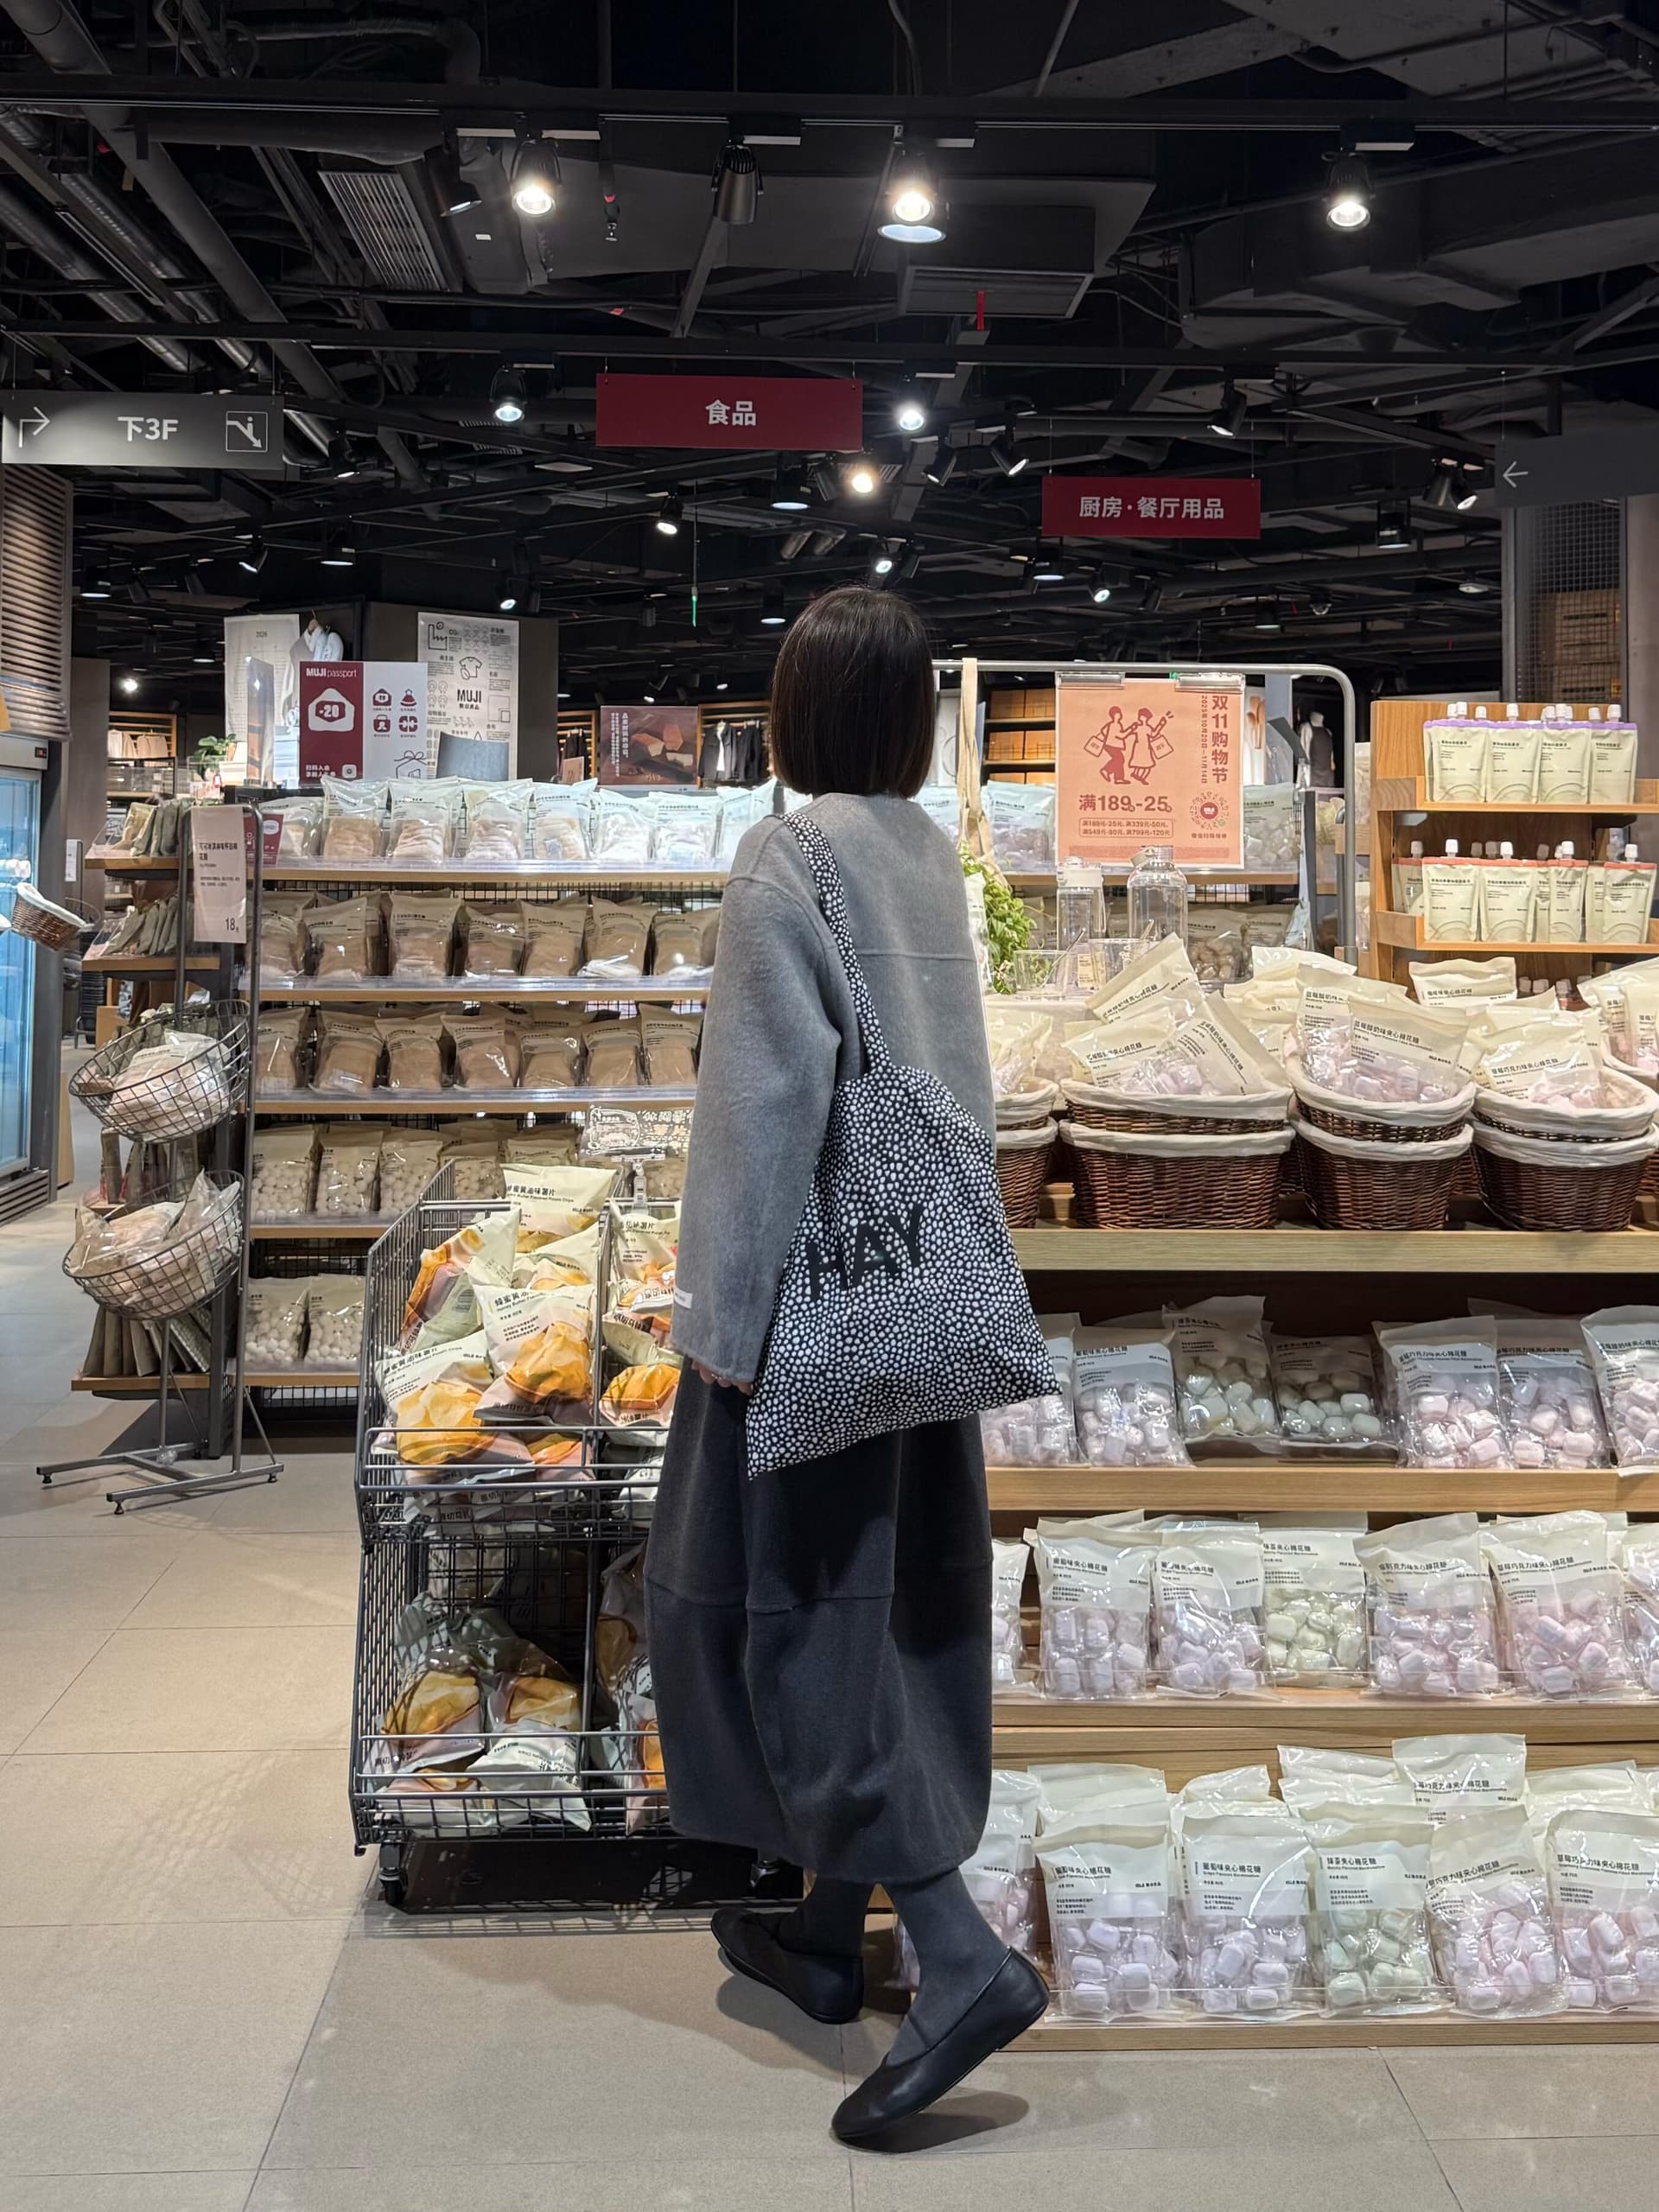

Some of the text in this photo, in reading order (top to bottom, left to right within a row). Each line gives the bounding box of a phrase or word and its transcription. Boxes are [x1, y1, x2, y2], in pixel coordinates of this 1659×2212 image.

[705, 399, 756, 426] 食品
[118, 416, 179, 442] 下3F
[1079, 496, 1224, 518] 厨房·餐厅用品
[306, 668, 357, 677] MUJI passport
[456, 689, 481, 703] MUJI
[319, 704, 340, 718] -20
[1211, 695, 1229, 784] 双11购物节
[805, 1204, 924, 1300] HAY
[1052, 1557, 1108, 1573] 葡萄味夹心棉花糖
[1203, 1862, 1262, 1873] 葡萄味夹心棉花糖
